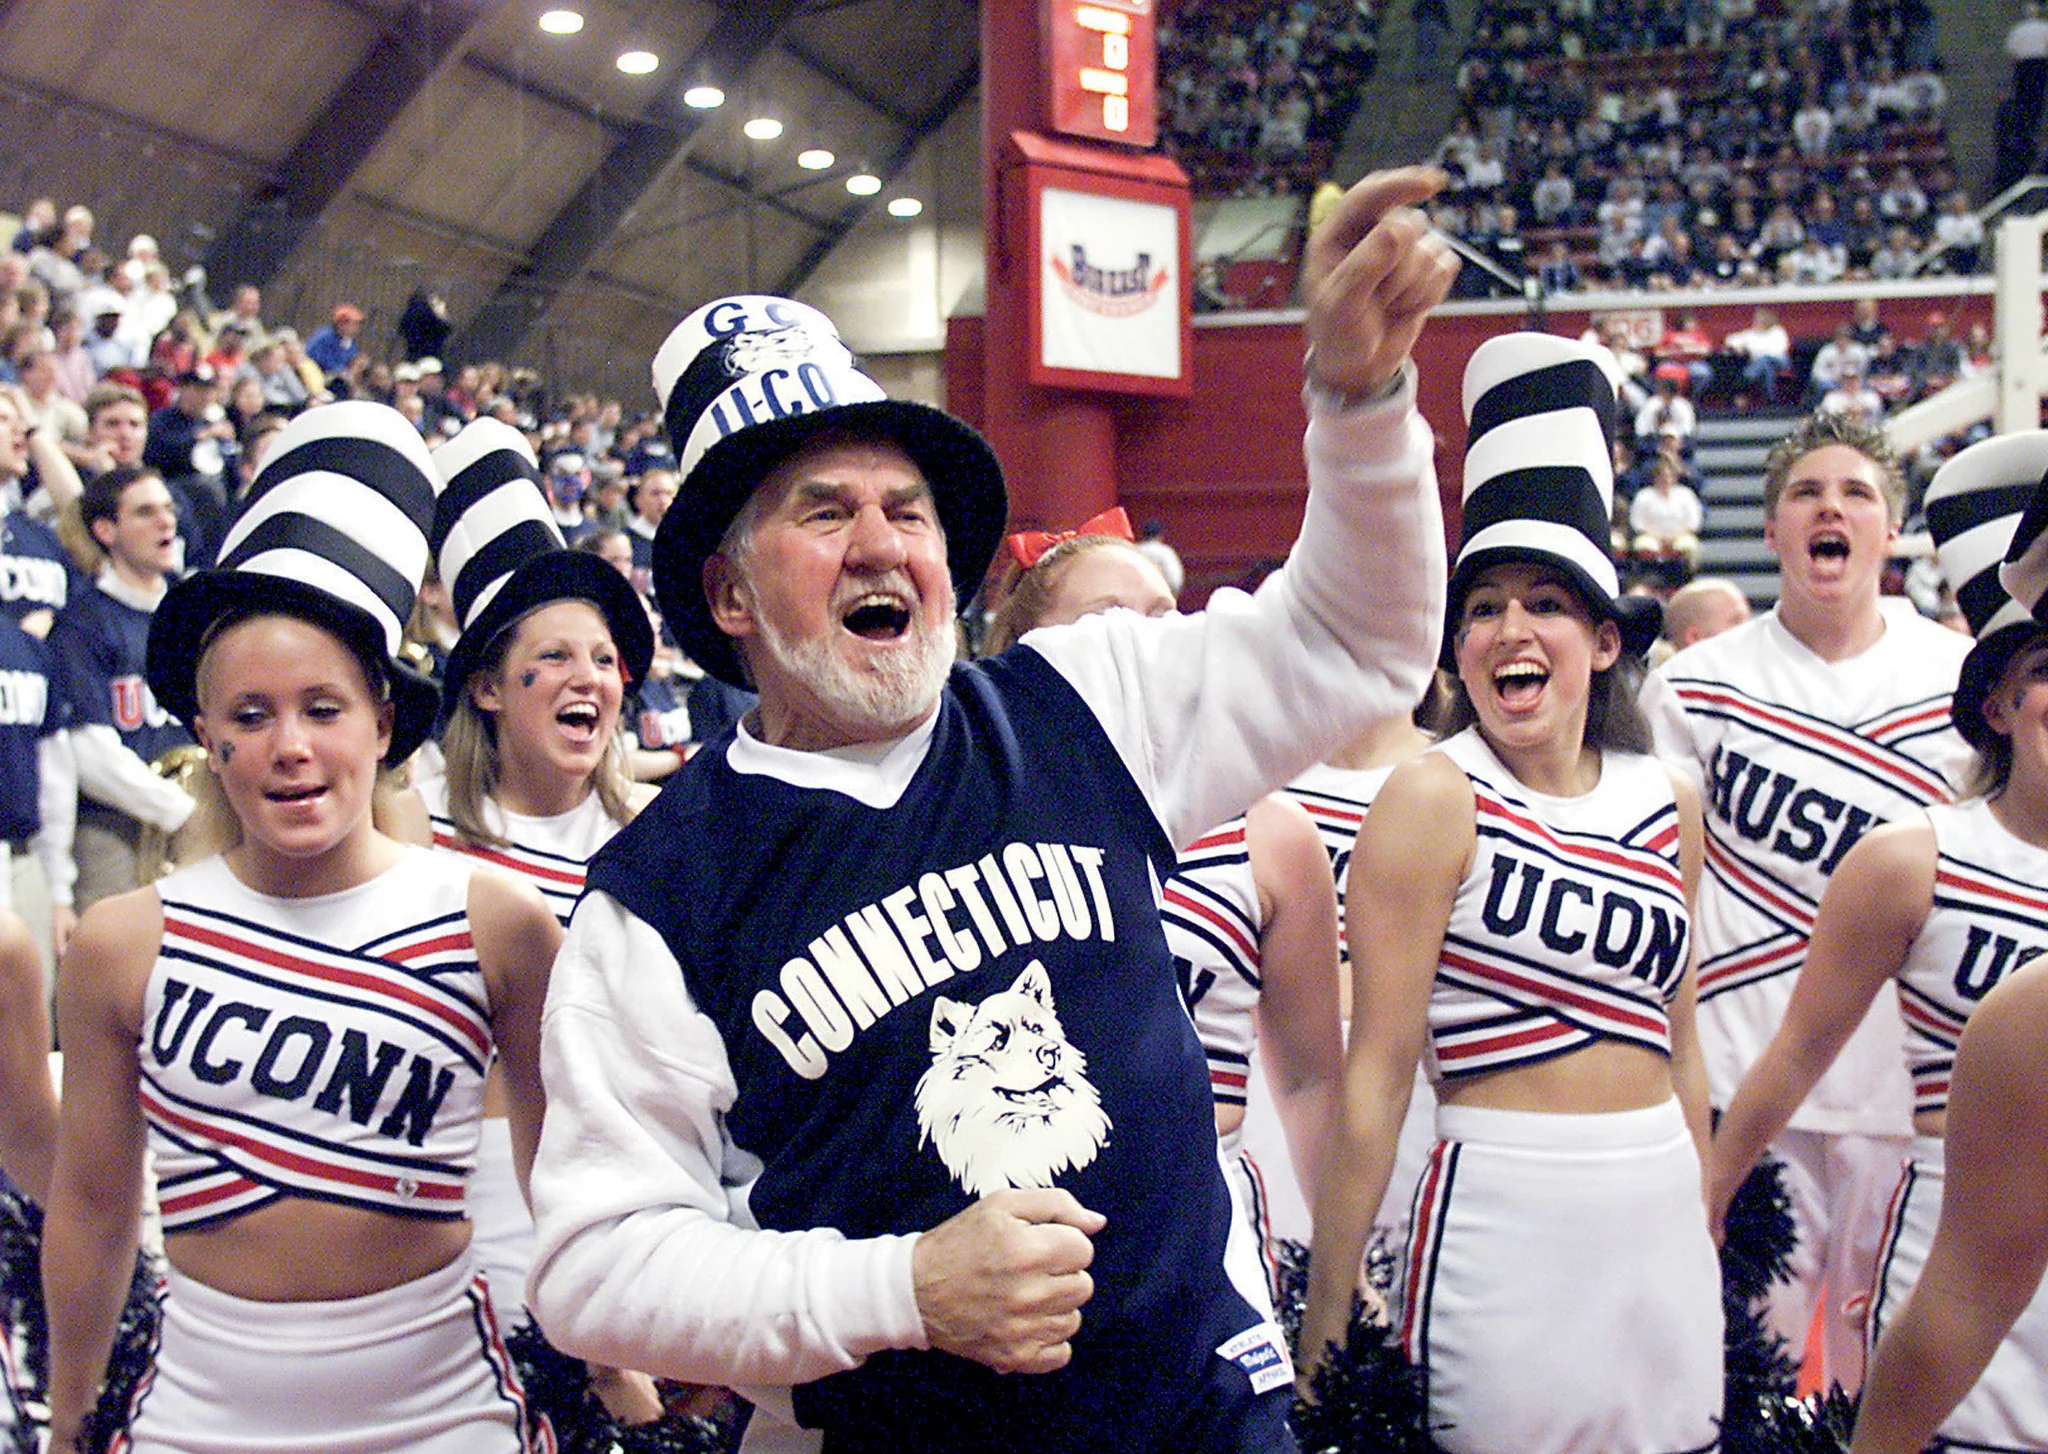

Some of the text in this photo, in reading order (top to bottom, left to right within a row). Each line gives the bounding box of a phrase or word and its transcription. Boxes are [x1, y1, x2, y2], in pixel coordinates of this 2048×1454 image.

[751, 841, 1115, 1080] CONNECTICUT
[1482, 853, 1688, 990] UCON
[151, 978, 456, 1147] UCONN
